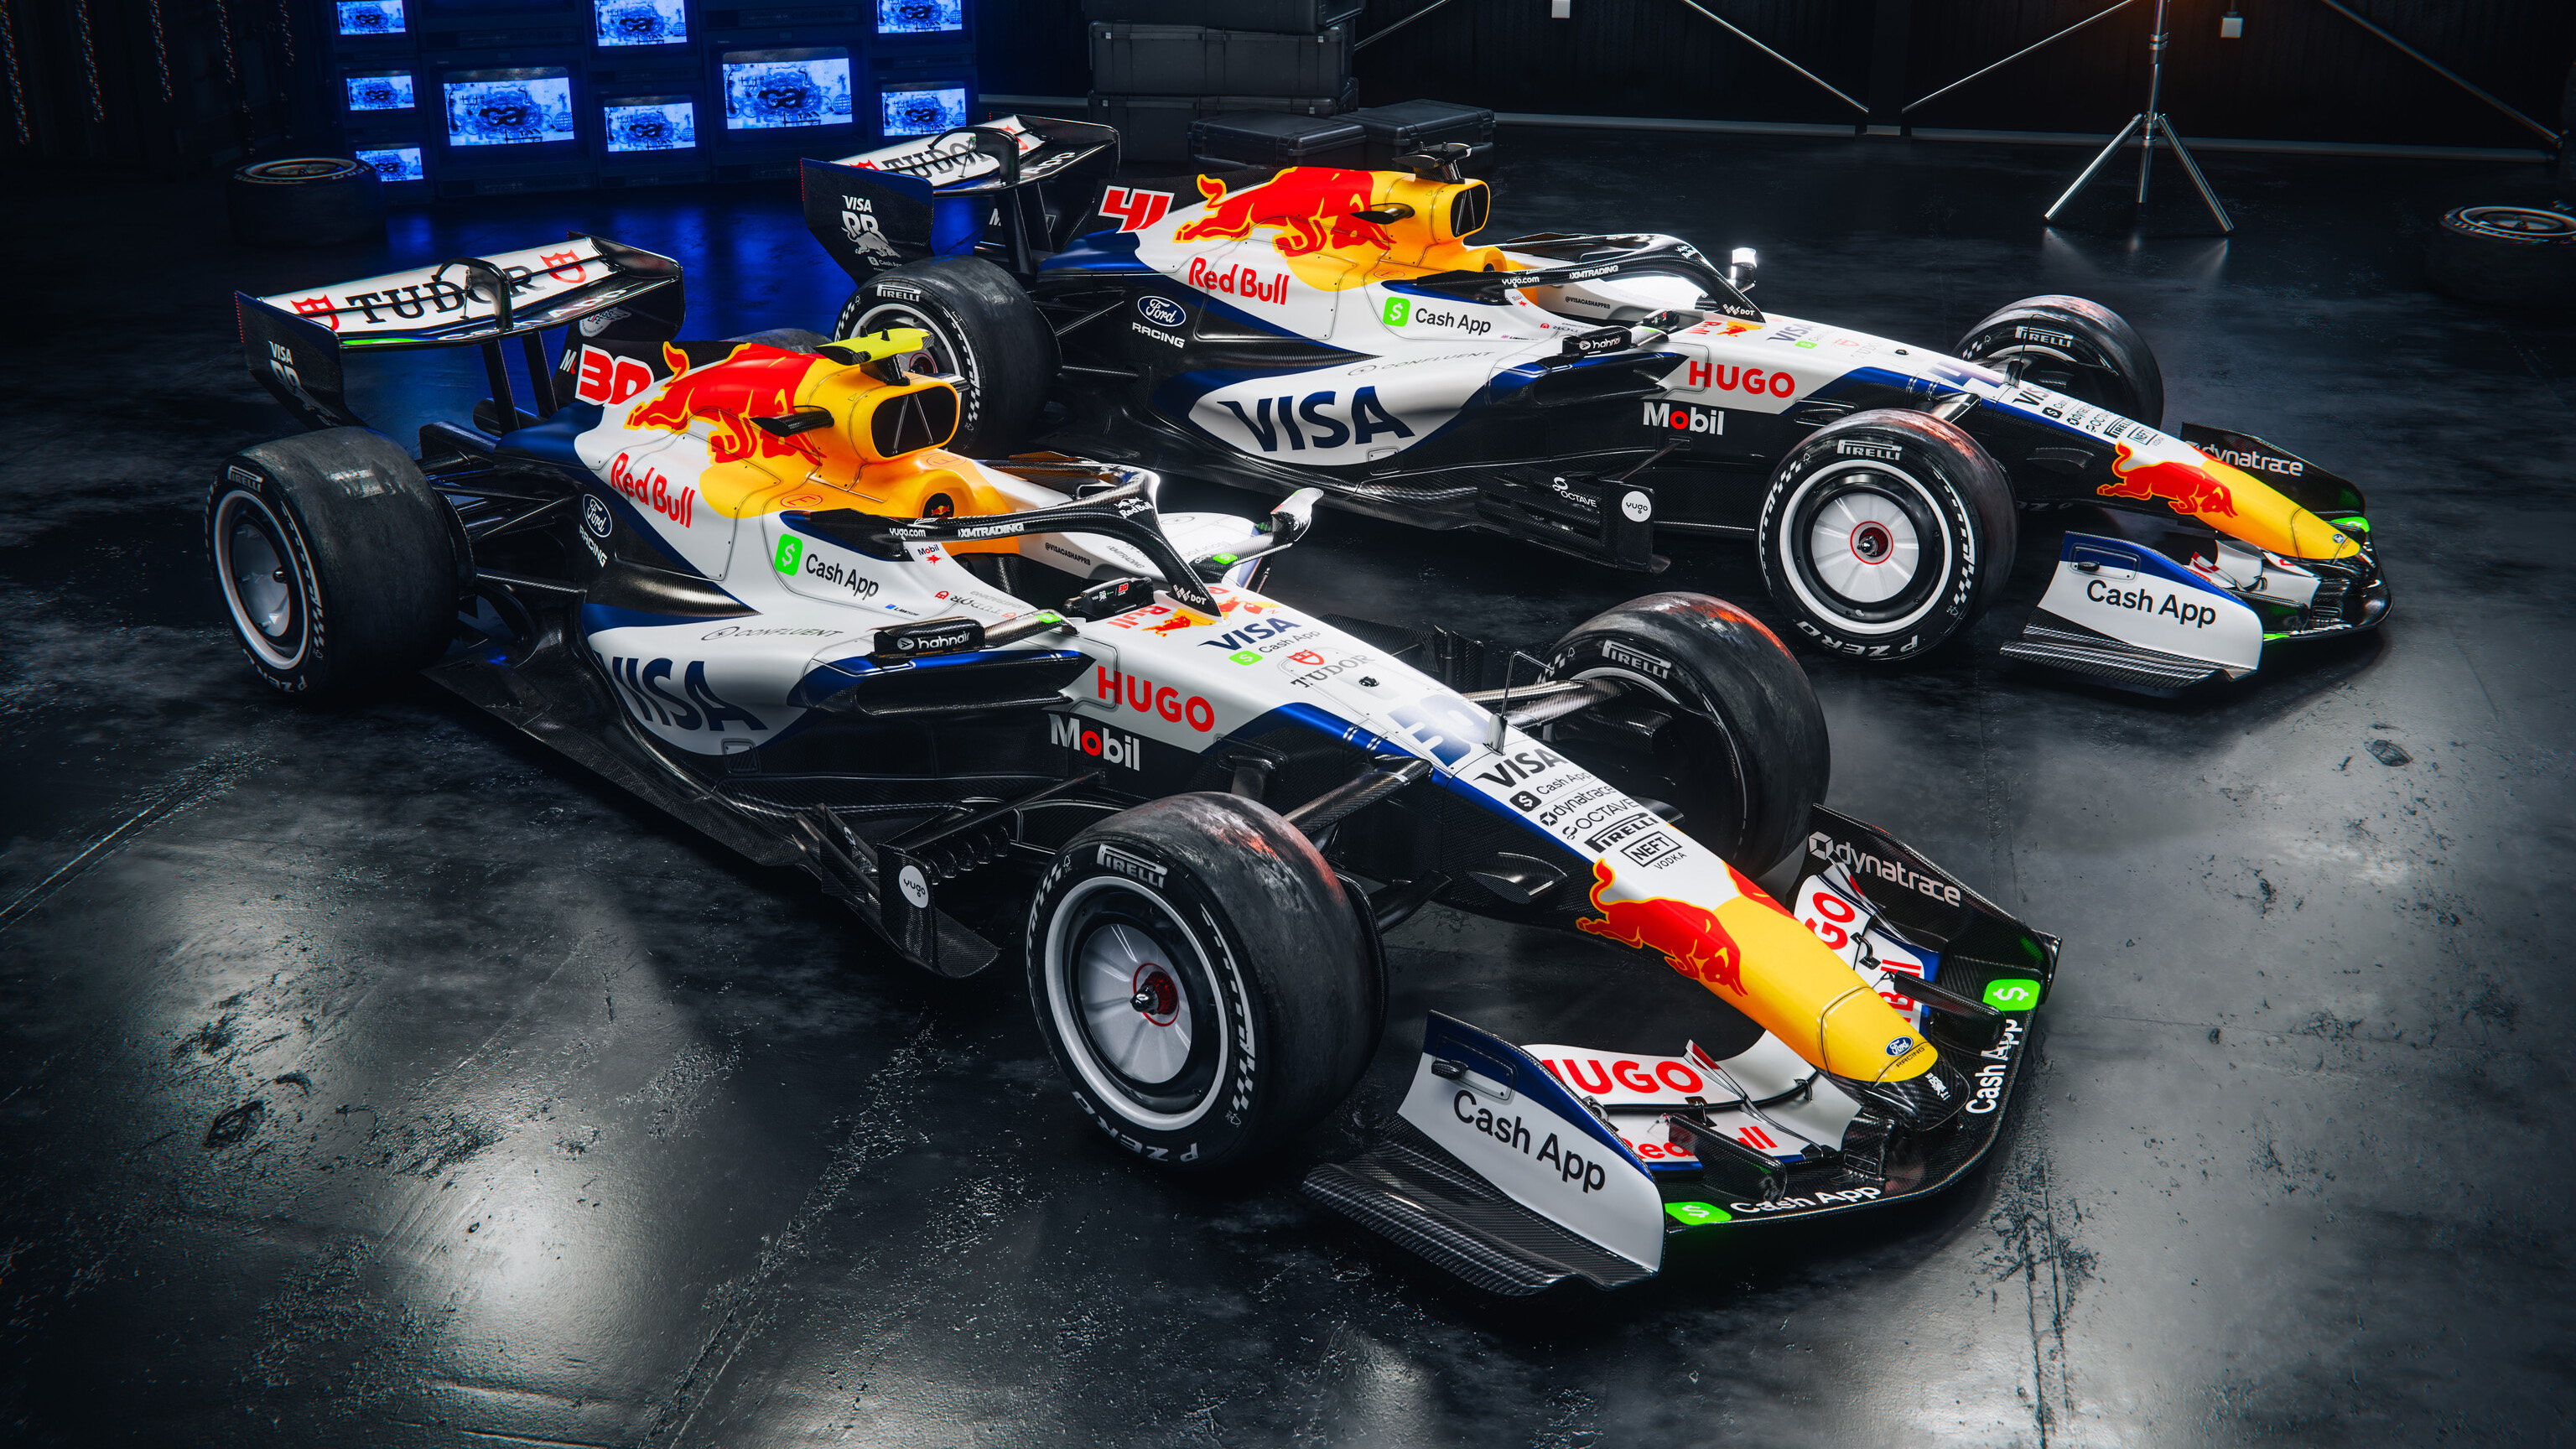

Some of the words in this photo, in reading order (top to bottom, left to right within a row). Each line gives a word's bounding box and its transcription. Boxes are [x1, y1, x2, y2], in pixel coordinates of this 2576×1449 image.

[841, 195, 873, 213] VISA
[877, 284, 922, 302] PIRELLI
[1188, 257, 1239, 293] Red
[1240, 267, 1290, 305] Bull
[1501, 275, 1540, 288] yugo.com
[1145, 298, 1177, 325] Ford
[1415, 308, 1455, 328] Cash
[1458, 314, 1492, 335] App
[1132, 322, 1186, 349] RACING
[2014, 325, 2074, 348] PIRELLI
[268, 340, 294, 366] VISA
[575, 344, 654, 408] 30
[1689, 360, 1795, 398] HUGO
[1216, 385, 1415, 453] VISA
[1643, 402, 1725, 435] Mobil
[1836, 439, 1903, 461] PIRELLI
[226, 464, 264, 493] PIRELLI
[610, 451, 655, 507] Red
[652, 474, 696, 529] Bull
[1561, 490, 1597, 508] OCTAVE
[1626, 501, 1649, 515] yugo
[585, 497, 608, 534] Ford
[579, 523, 609, 569] RACING
[889, 527, 927, 541] yugo.com
[917, 543, 940, 556] Mobil
[805, 553, 844, 584] Cash
[844, 569, 880, 601] App
[1119, 583, 1129, 592] 30
[1172, 584, 1191, 602] REBEL
[1190, 595, 1208, 605] DOT
[2086, 579, 2153, 613] Cash
[2158, 594, 2217, 629] App
[735, 628, 844, 637] CONFLUENT
[917, 630, 970, 650] hahnair
[1197, 617, 1304, 652] VISA
[1258, 636, 1293, 655] Cash
[1292, 629, 1322, 645] App
[1289, 653, 1376, 689] TUDOR
[1601, 638, 1673, 681] PIRELLI
[1098, 665, 1216, 734] HUGO
[1048, 713, 1140, 771] Mobil
[1472, 748, 1570, 788] VISA
[1536, 776, 1566, 796] Cash
[1566, 771, 1592, 787] App
[1553, 784, 1616, 818] dynatrace
[1576, 797, 1640, 829] OCTAVE
[1584, 812, 1660, 853] PIRELLI
[1630, 835, 1671, 863] NEFT
[1653, 851, 1687, 870] VODKA
[1096, 843, 1169, 890] PIRELLI
[1834, 841, 1961, 908] dynatrace
[903, 878, 926, 898] yugo
[1888, 1039, 1911, 1057] Ford
[1895, 1046, 1926, 1069] RACING
[1966, 1064, 2007, 1115] Cash
[1453, 1089, 1532, 1155] Cash
[1536, 1132, 1607, 1194] App
[1729, 1195, 1816, 1214] Cash
[1813, 1186, 1883, 1206] App
